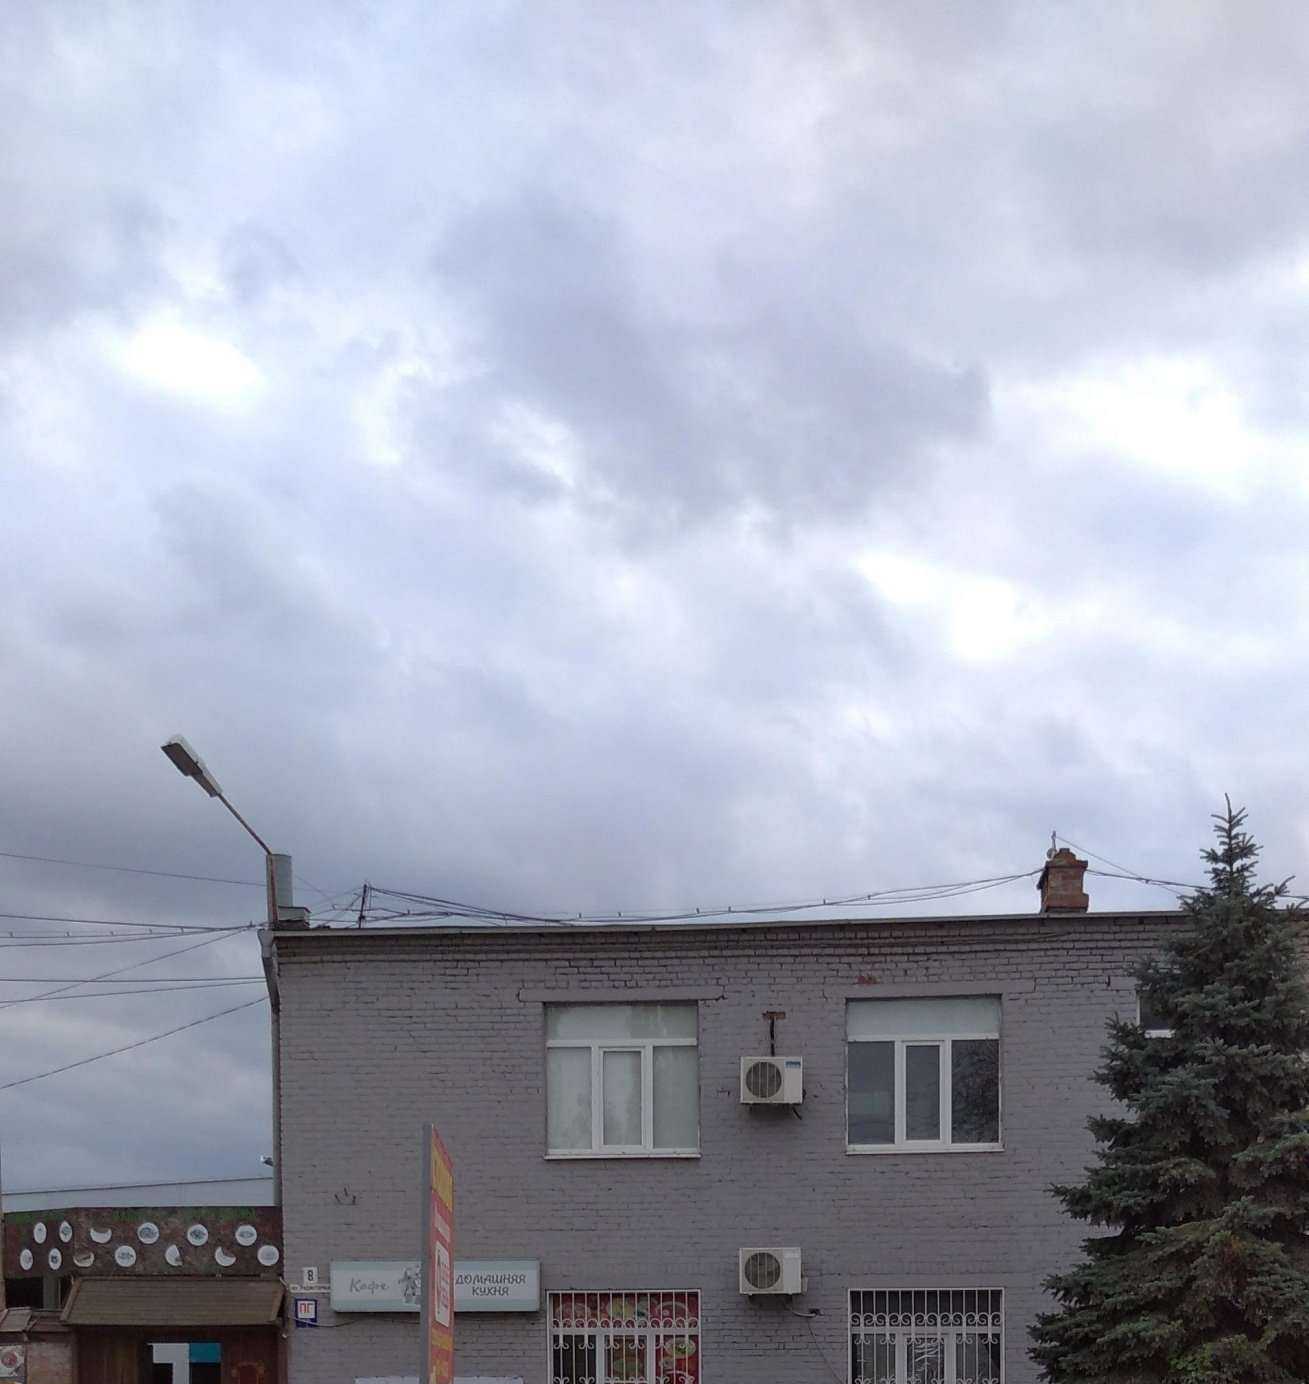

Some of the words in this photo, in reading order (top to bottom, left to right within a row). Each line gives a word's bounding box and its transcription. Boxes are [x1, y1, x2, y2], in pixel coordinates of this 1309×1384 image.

[307, 1269, 314, 1281] 8
[455, 1272, 526, 1285] ДОМАШНЯЯ
[349, 1277, 389, 1296] Кафе
[472, 1286, 509, 1297] КУХНЯ
